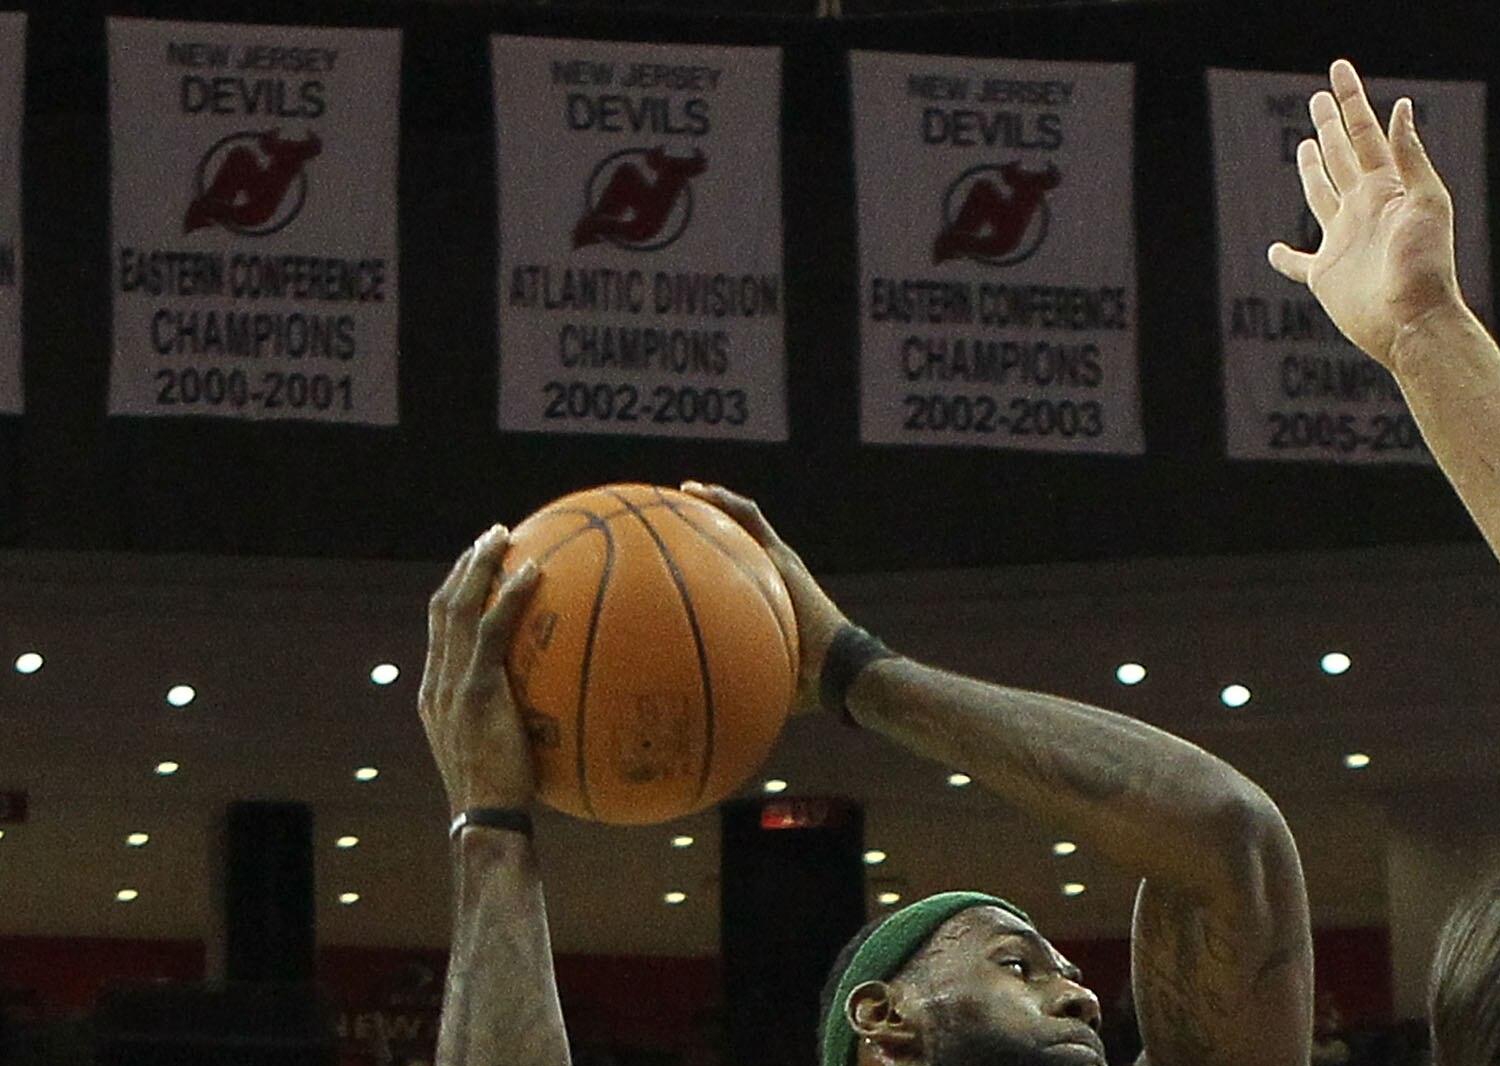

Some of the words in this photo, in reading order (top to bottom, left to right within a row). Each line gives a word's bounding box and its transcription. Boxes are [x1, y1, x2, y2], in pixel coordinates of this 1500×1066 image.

[168, 42, 230, 67] NEW
[237, 45, 339, 72] JERSEY
[552, 60, 613, 85] NEW
[621, 63, 721, 90] JERSEY
[181, 75, 325, 118] DEVILS
[567, 93, 710, 135] DEVILS
[923, 108, 1063, 150] DEVILS
[120, 248, 223, 297] EASTERN
[231, 253, 385, 301] CONFERENCE
[510, 266, 644, 314] ATLANTIC
[655, 271, 778, 317] DIVISION
[871, 278, 972, 323] EASTERN
[151, 309, 356, 360] CHAMPIONS
[560, 324, 727, 374] CHAMPIONS
[902, 336, 1102, 386] CHAMPIONS
[156, 368, 354, 411] 2000-2001
[543, 383, 748, 425] 2002-2003
[903, 394, 1102, 436] 2002-2003
